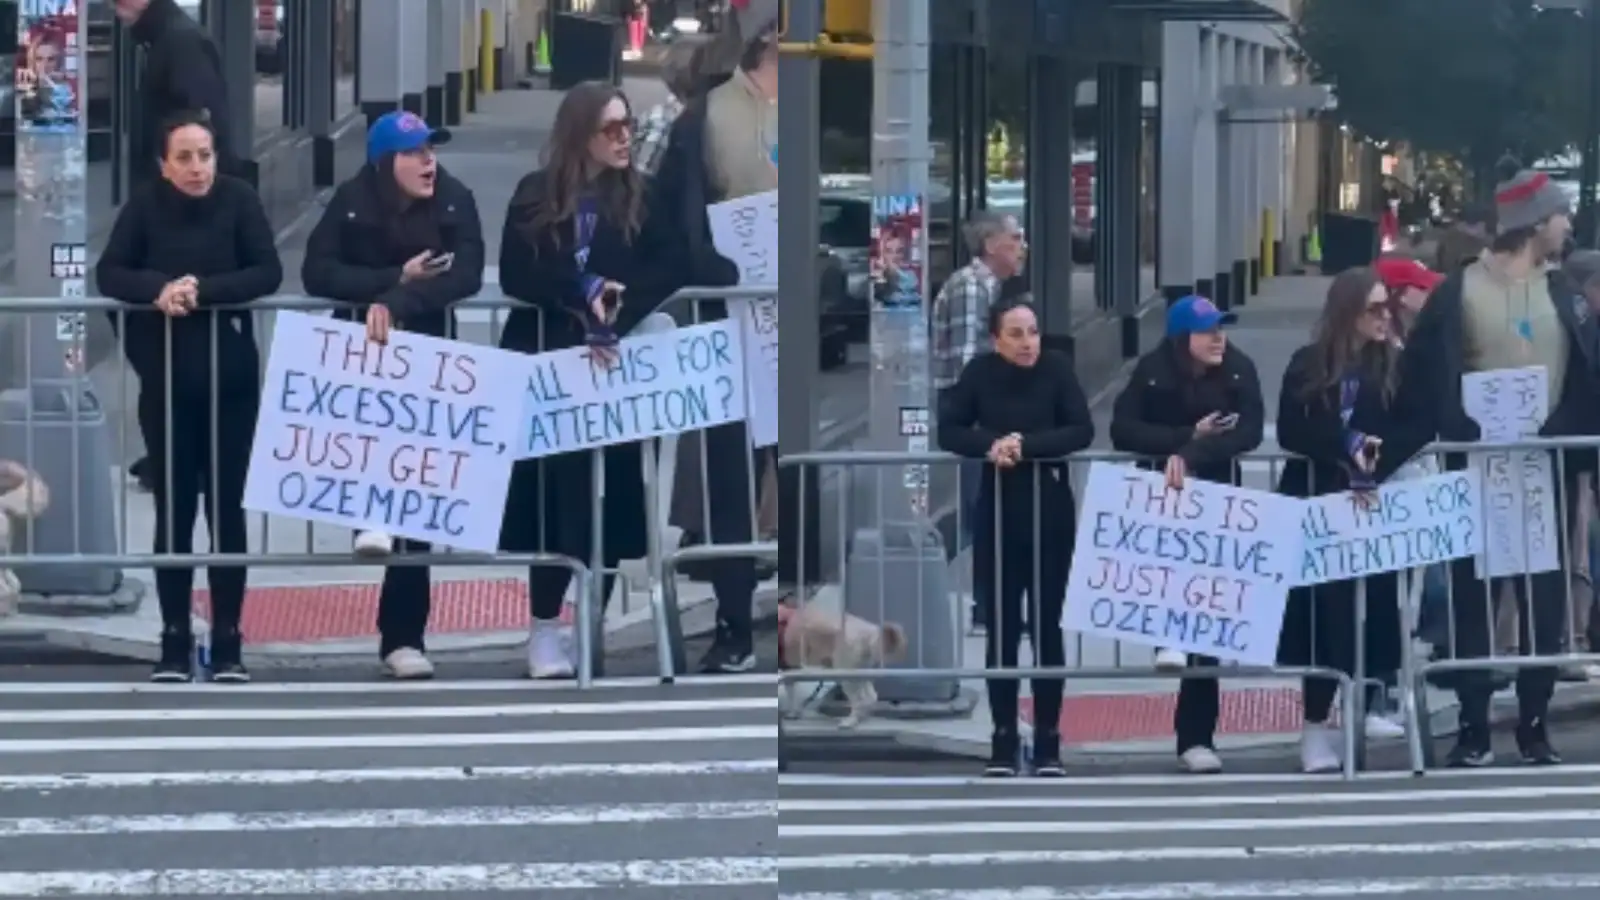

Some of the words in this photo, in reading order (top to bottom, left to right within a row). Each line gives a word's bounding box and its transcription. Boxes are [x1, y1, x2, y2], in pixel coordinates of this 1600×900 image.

[312, 326, 410, 379] THIS
[430, 350, 478, 395] IS
[676, 329, 733, 375] FOR
[280, 370, 506, 454] EXCESSIVE,
[273, 424, 381, 473] JUST
[389, 444, 471, 491] GET
[278, 472, 470, 536] OZEMPIC
[1122, 476, 1204, 521] THIS
[1219, 499, 1259, 533] IS
[1424, 476, 1472, 517] FOR
[1093, 511, 1284, 584] EXCESSIVE,
[1087, 556, 1176, 600] JUST
[1183, 575, 1253, 613] GET
[1090, 599, 1252, 652] OZEMPIC
